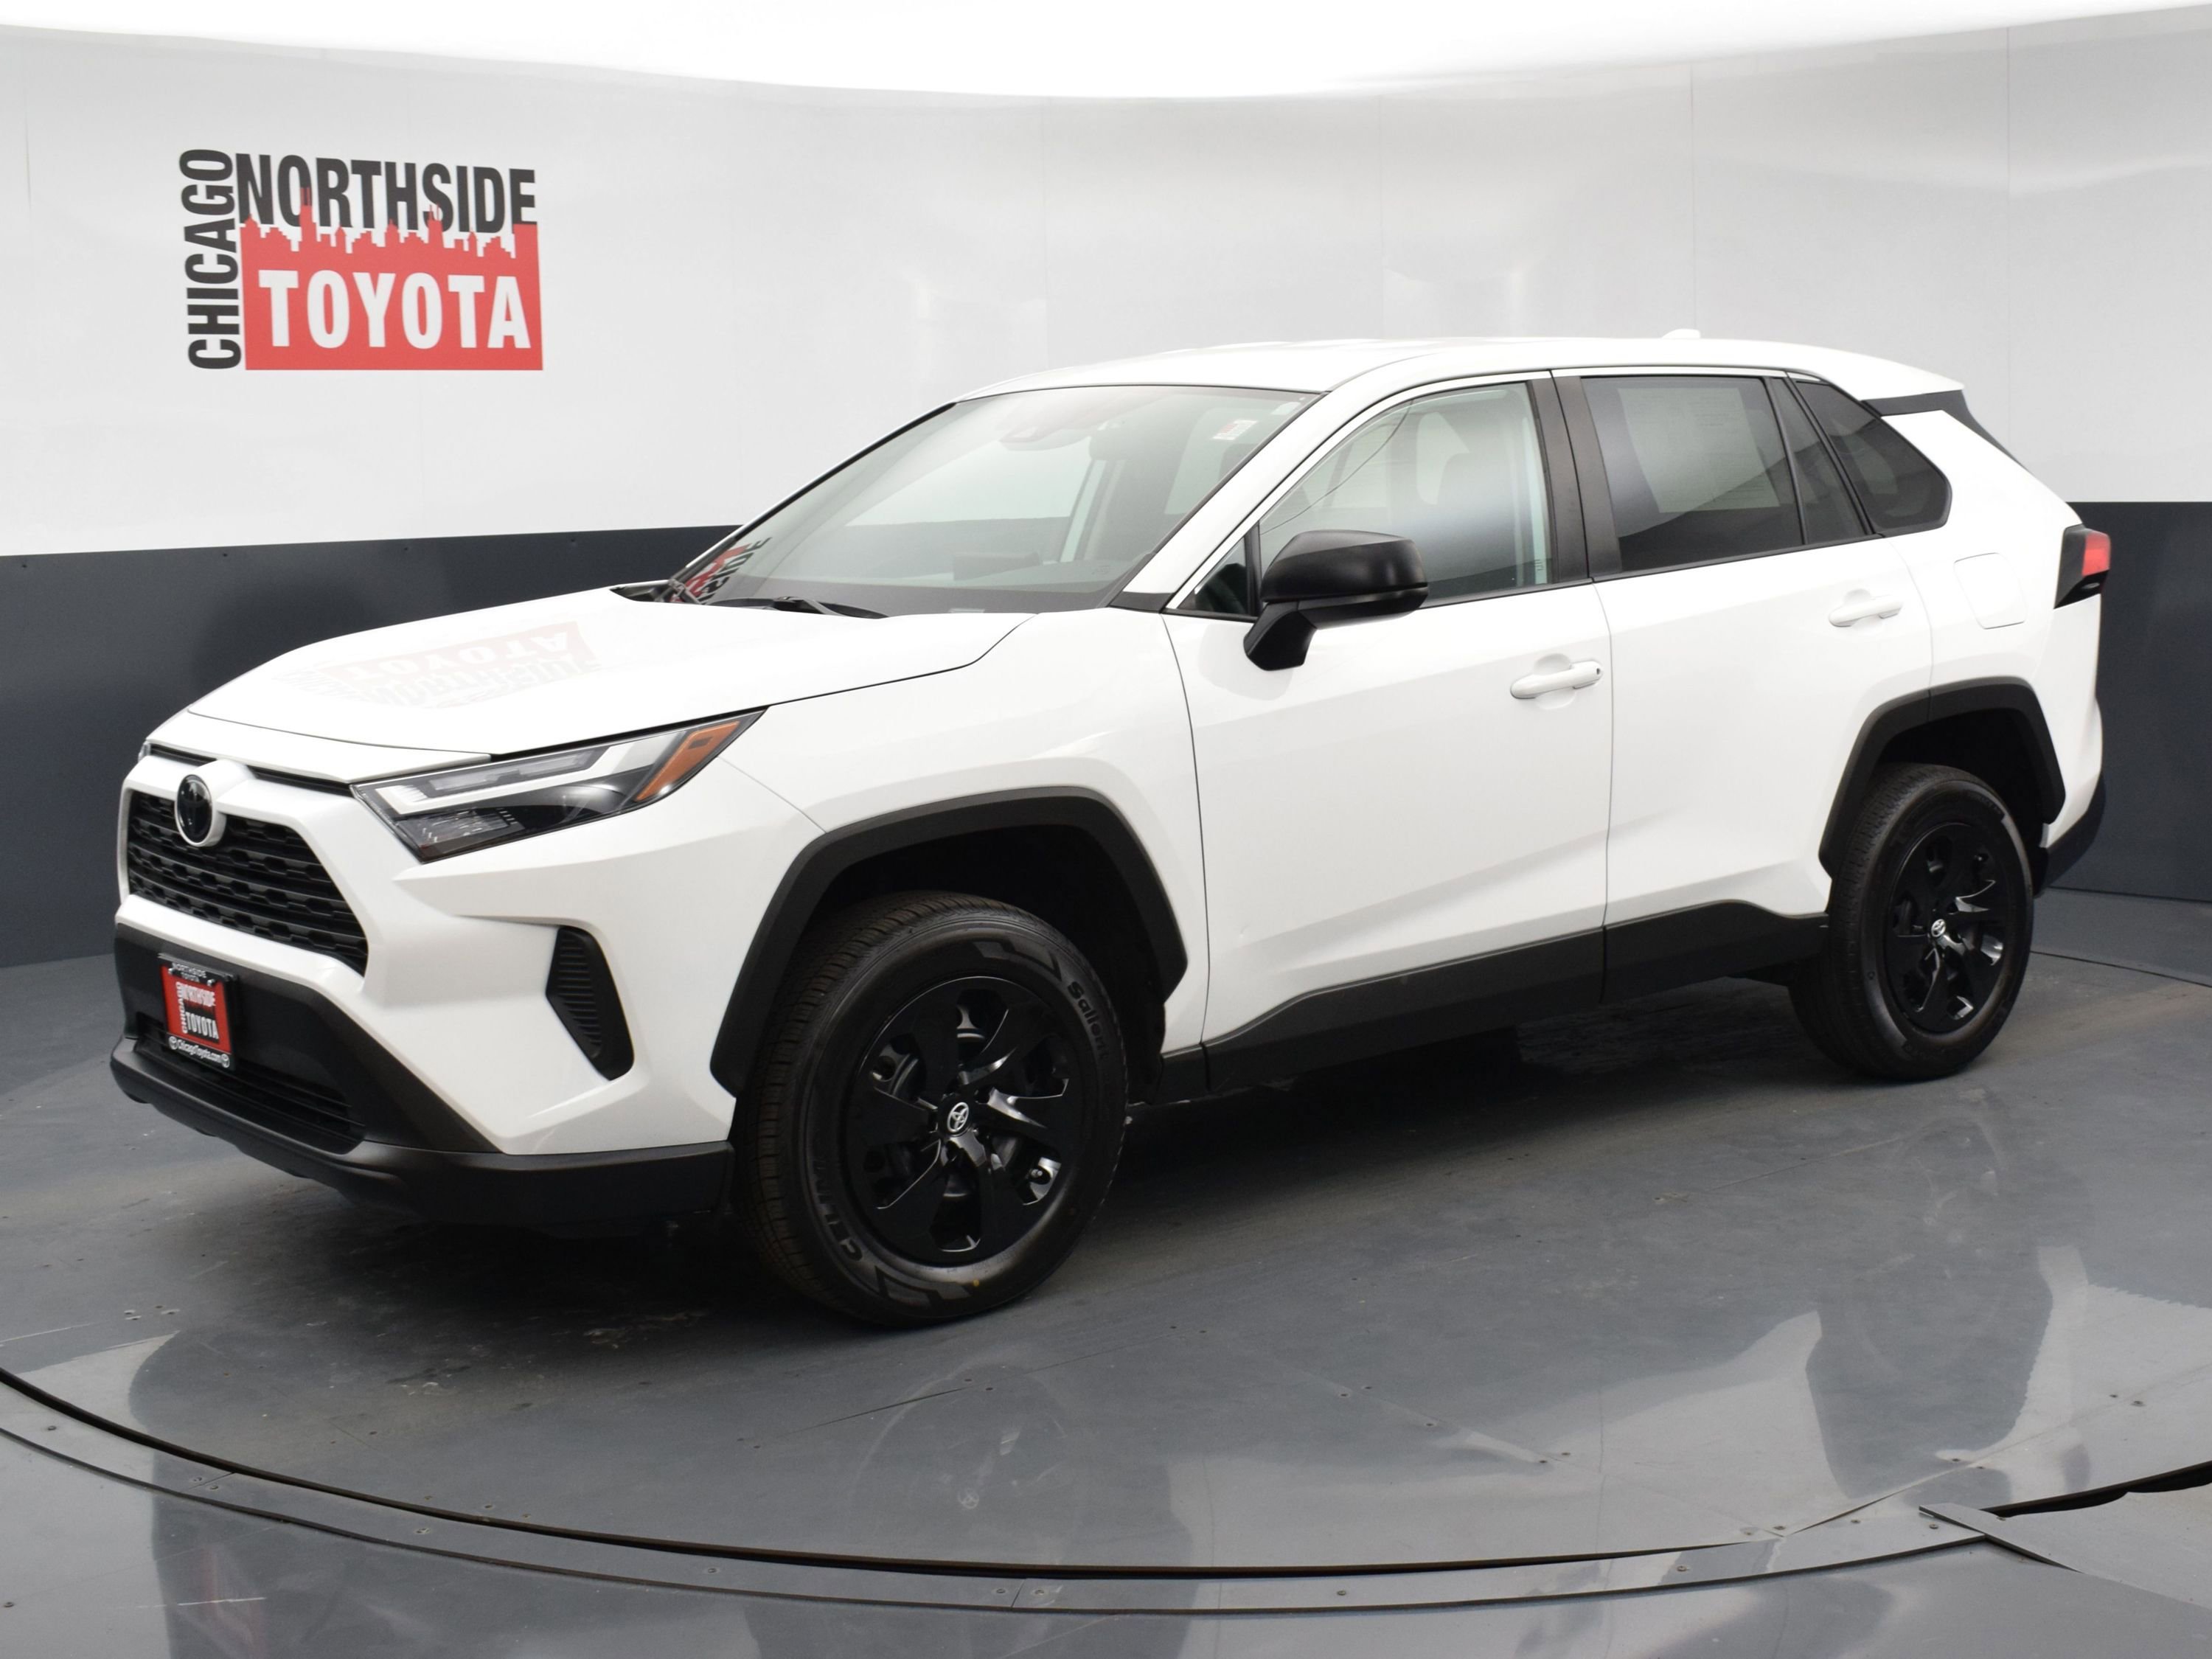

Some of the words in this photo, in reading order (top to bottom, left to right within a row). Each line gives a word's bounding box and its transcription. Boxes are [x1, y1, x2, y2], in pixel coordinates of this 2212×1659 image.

[235, 153, 538, 234] NORTHSIDE
[178, 148, 242, 369] CHICAGO
[258, 269, 531, 349] TOYOTA
[185, 1011, 219, 1040] TOYOTA
